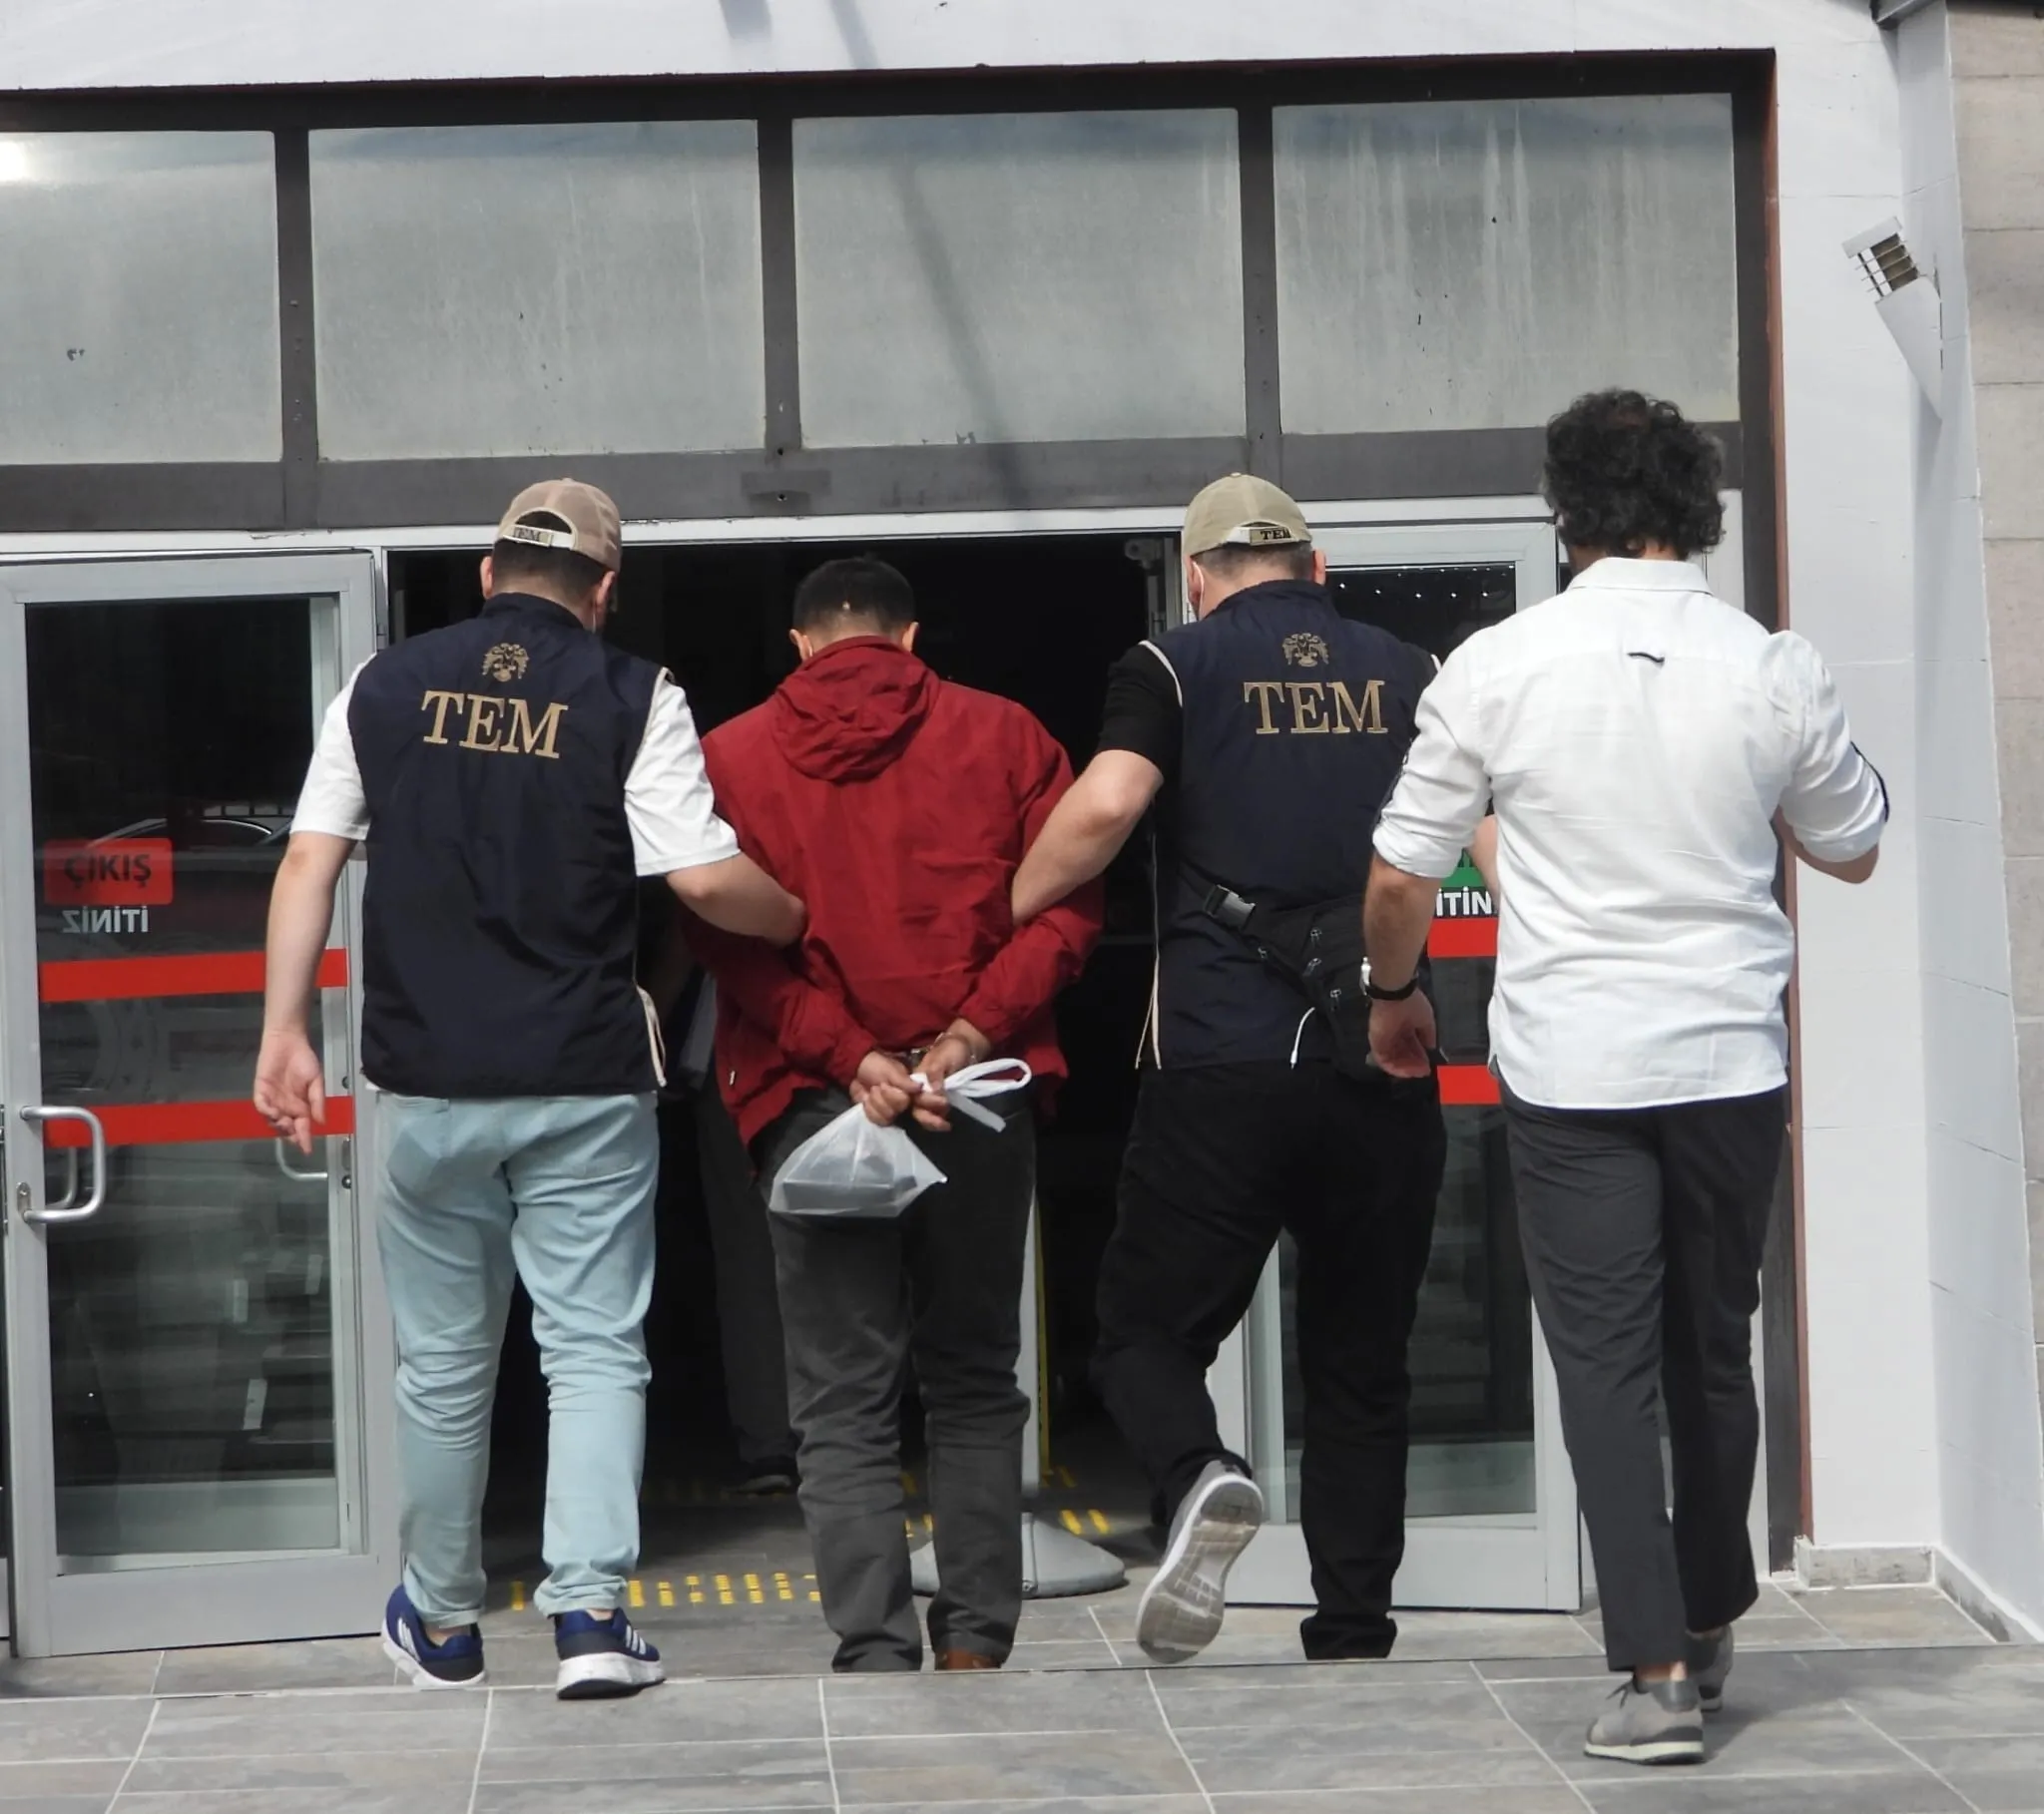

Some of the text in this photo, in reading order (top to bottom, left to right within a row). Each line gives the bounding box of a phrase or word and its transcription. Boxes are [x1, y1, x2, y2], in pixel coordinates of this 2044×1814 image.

[421, 689, 568, 758] TEM
[1244, 680, 1388, 734] TEM
[64, 854, 152, 889] ÇIKIŞ
[1436, 886, 1492, 916] İTİN
